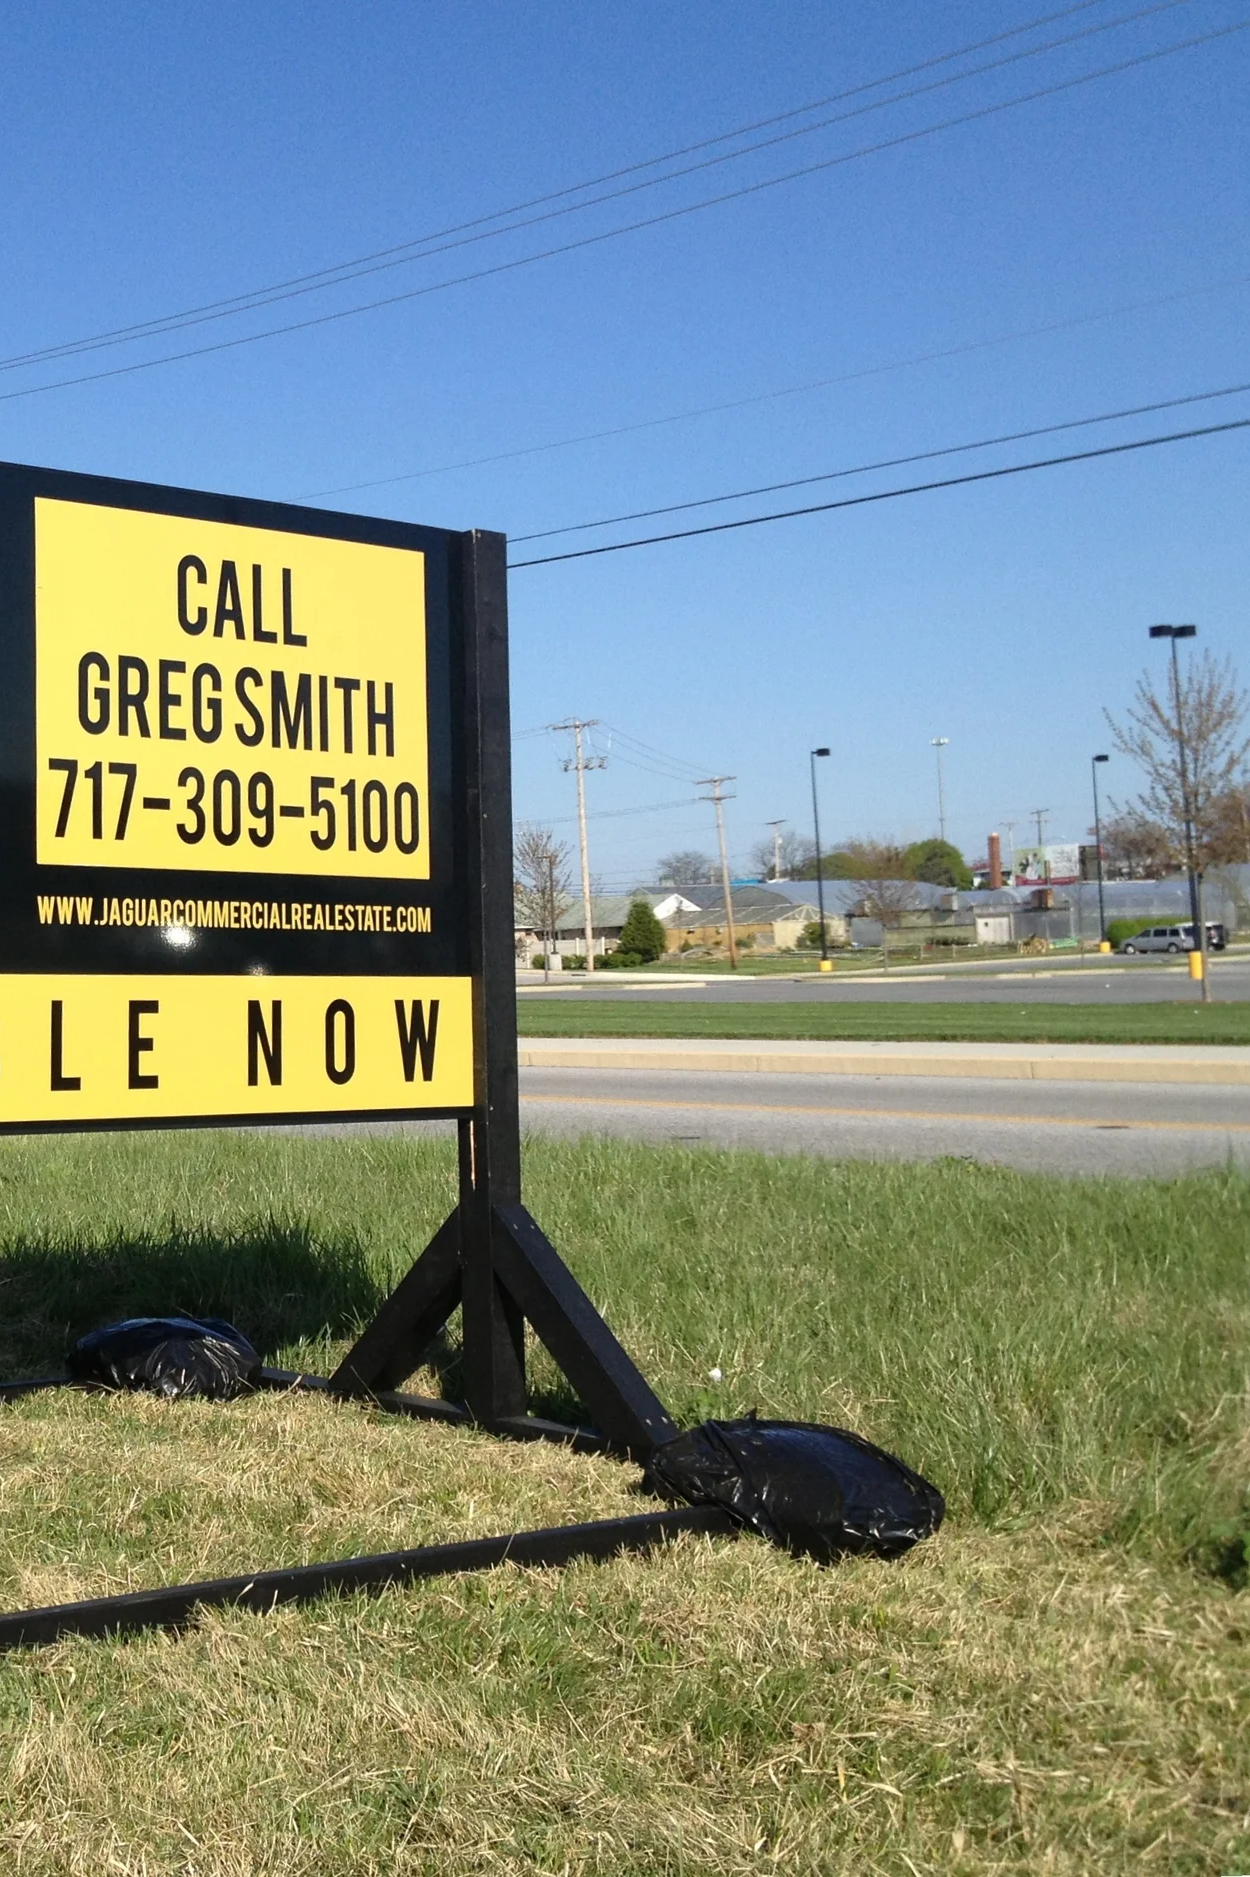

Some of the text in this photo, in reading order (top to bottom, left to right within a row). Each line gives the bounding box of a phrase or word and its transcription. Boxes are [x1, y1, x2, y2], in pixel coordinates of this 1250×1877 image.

[177, 554, 308, 648] CALL
[78, 651, 395, 758] GREG SMITH
[48, 757, 420, 855] 717-309-5100
[37, 895, 431, 933] WWW.JAGUARCOMMERCIALREALESTATE.COM
[247, 998, 440, 1087] NOW
